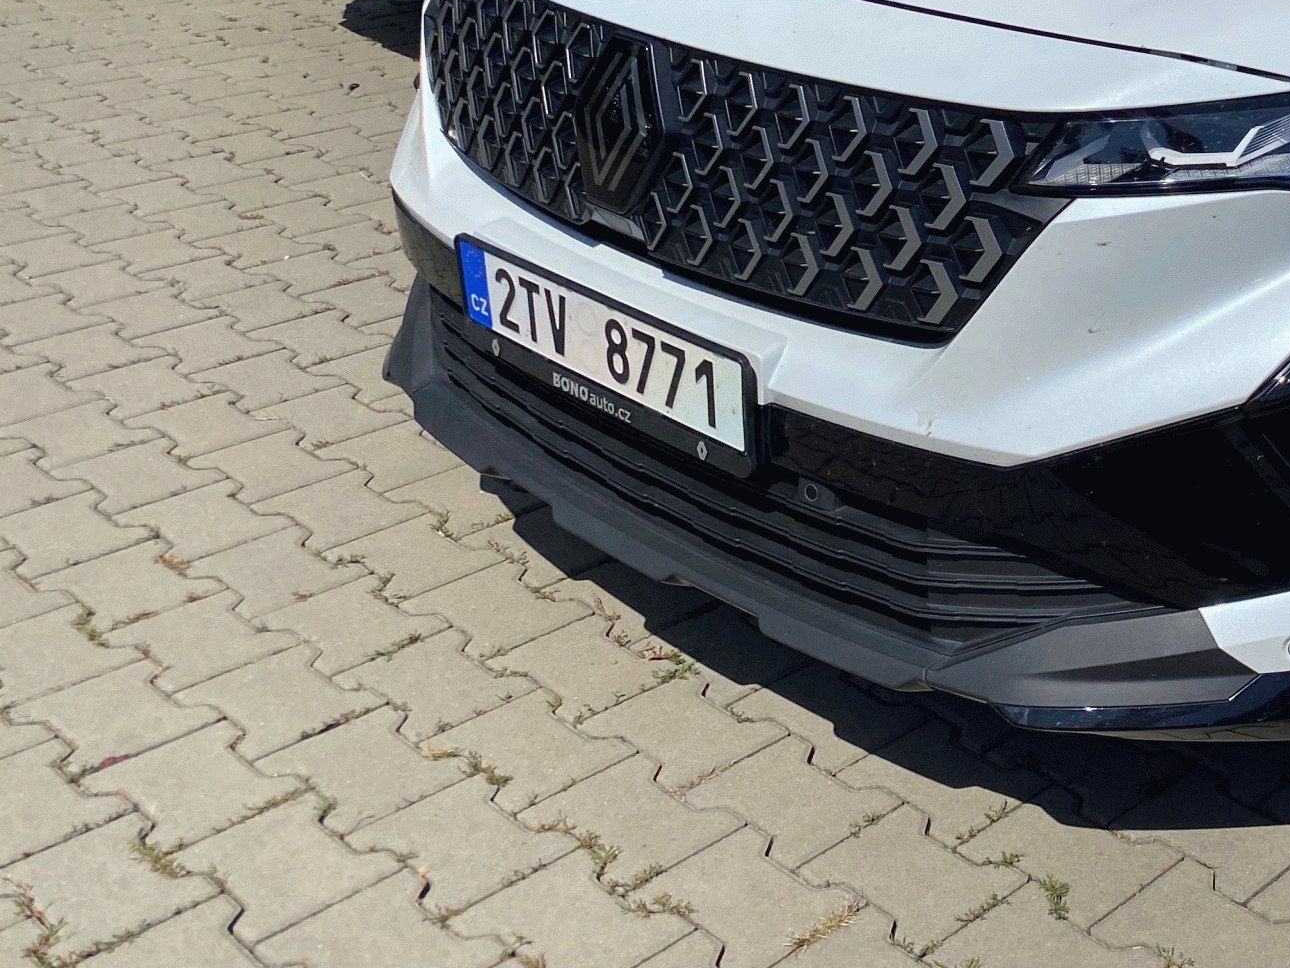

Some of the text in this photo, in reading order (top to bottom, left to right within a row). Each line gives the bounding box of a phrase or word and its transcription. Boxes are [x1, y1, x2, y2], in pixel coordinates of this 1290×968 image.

[471, 294, 489, 316] CZ
[495, 268, 717, 429] 2TV 8771
